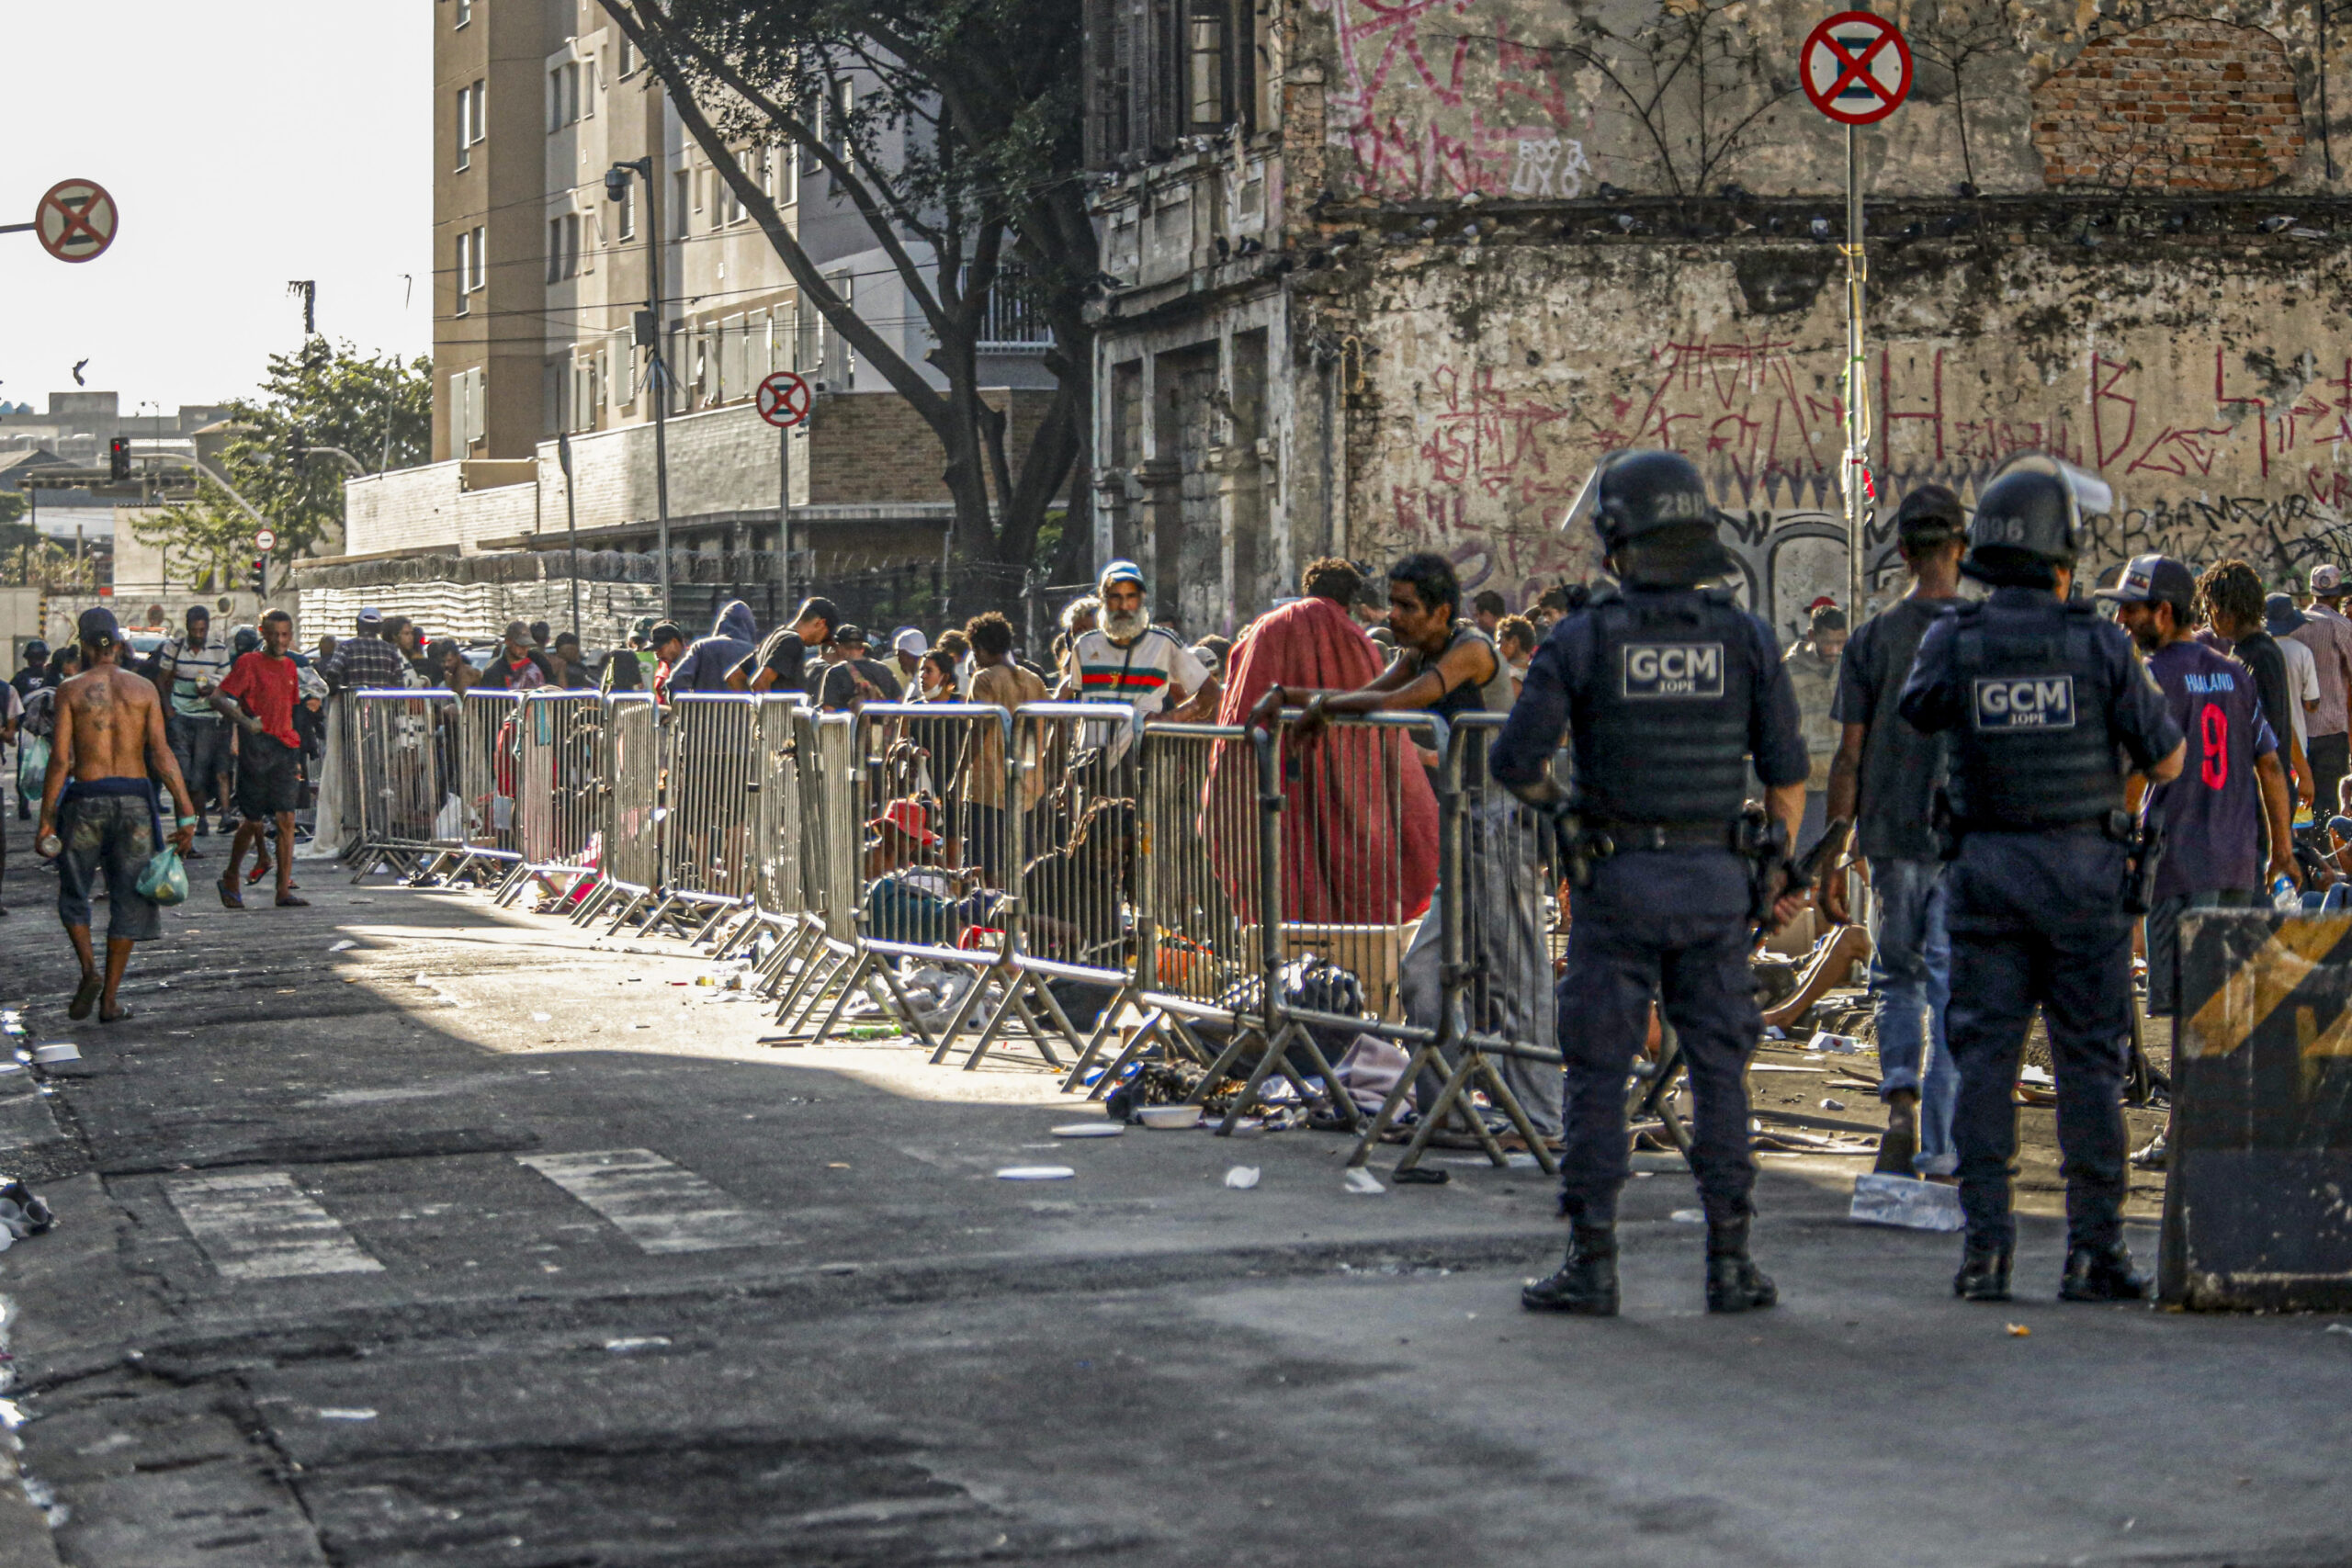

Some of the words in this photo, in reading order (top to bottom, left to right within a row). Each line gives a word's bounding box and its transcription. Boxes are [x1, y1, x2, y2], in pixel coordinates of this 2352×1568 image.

[1632, 648, 1717, 680] GCM
[1982, 681, 2067, 713] GCM
[2201, 703, 2228, 790] 9
